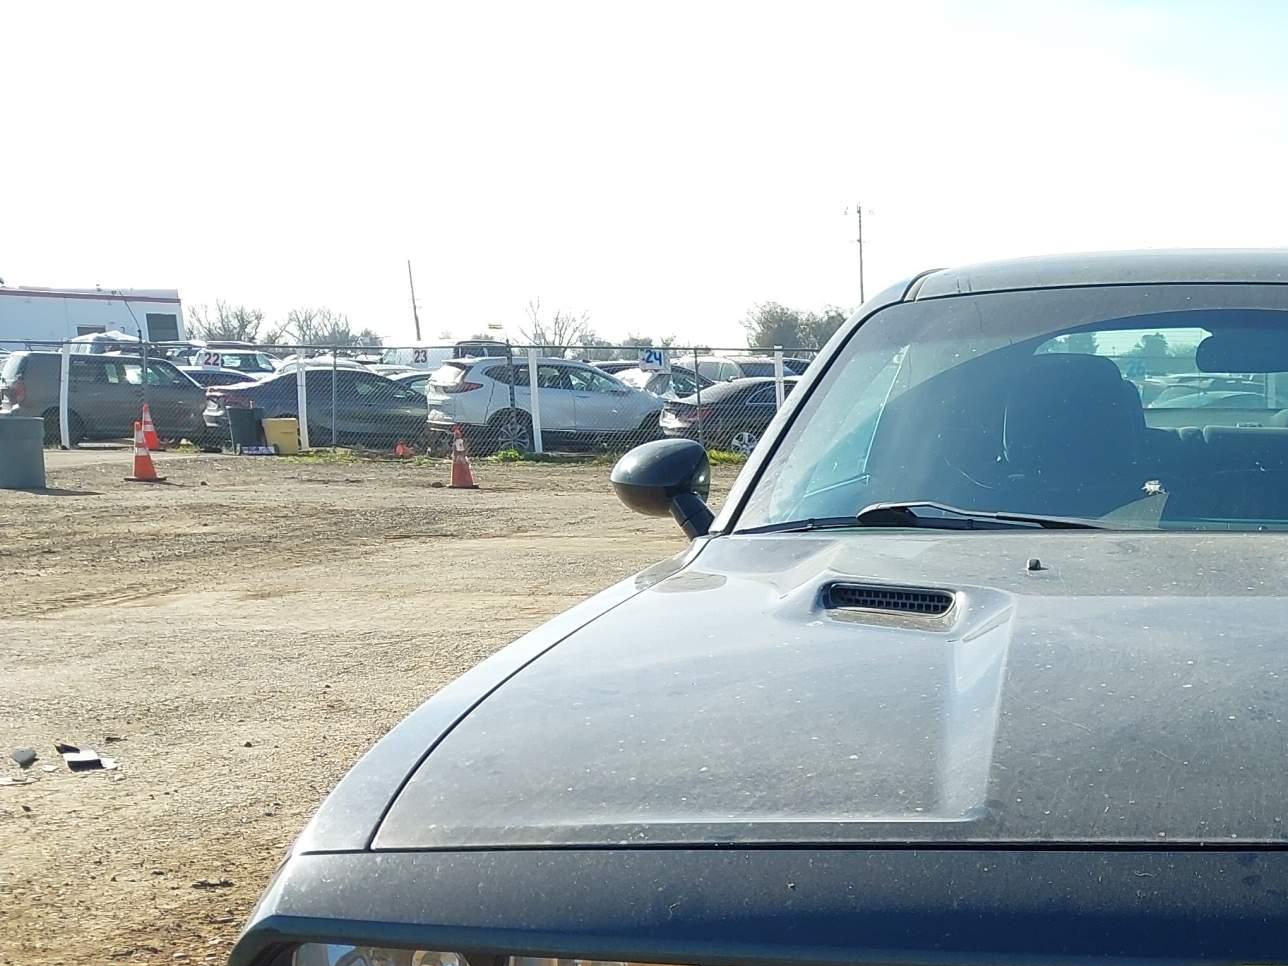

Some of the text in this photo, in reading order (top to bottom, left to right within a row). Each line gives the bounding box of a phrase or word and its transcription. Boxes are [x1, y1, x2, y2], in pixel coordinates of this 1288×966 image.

[203, 352, 220, 367] 22
[413, 349, 428, 364] 23
[645, 349, 663, 367] 24
